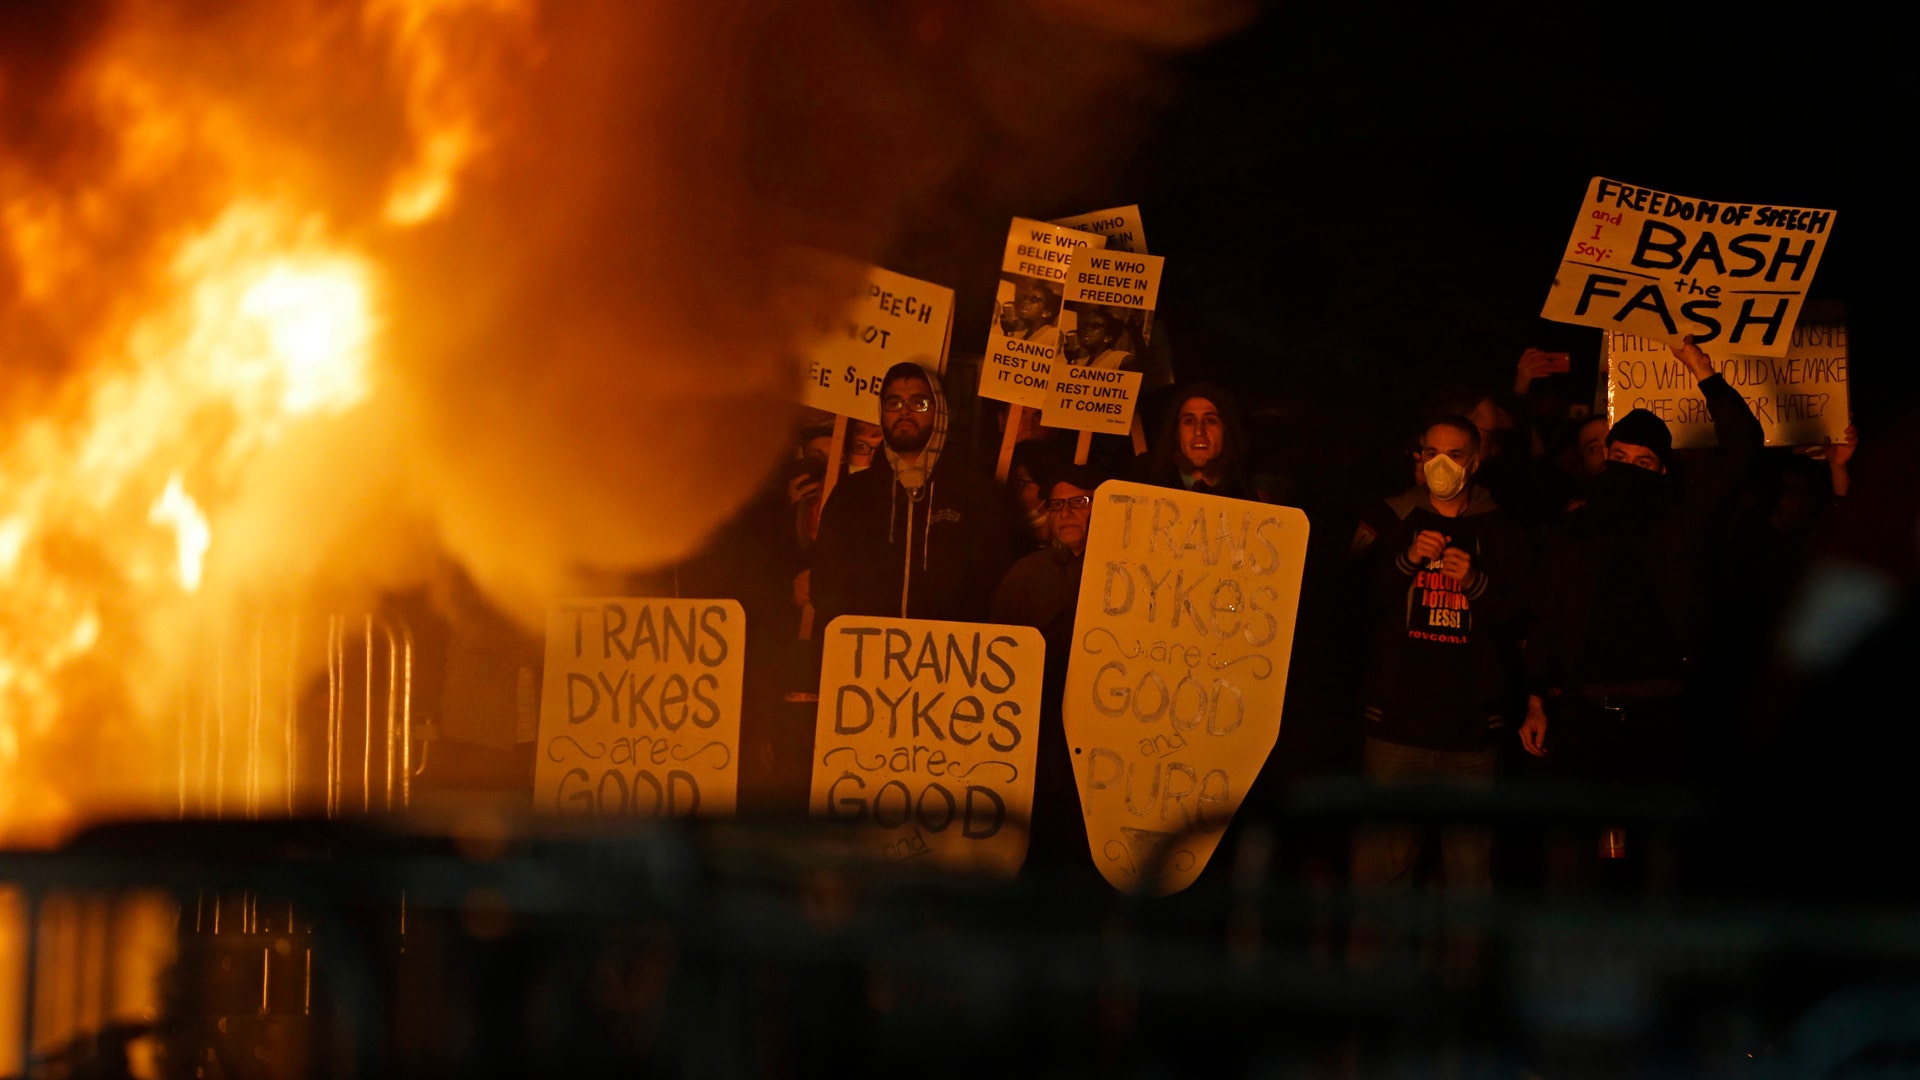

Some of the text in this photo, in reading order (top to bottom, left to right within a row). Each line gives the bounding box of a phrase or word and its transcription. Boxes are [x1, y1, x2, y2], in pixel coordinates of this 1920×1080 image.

[1591, 209, 1622, 226] and
[1596, 180, 1830, 234] FREEDOM OF SPEECH
[1092, 217, 1124, 231] WHO
[1591, 224, 1604, 240] I
[1031, 230, 1053, 244] WE
[1017, 245, 1072, 265] BELIEVE
[1631, 219, 1816, 281] BASH
[1090, 257, 1145, 274] WE WHO
[1078, 272, 1148, 290] BELIEVE IN
[1674, 278, 1722, 299] the
[1080, 289, 1144, 306] FREEDOM
[1574, 274, 1789, 346] FASH
[993, 353, 1028, 369] REST
[1006, 340, 1054, 359] CANNO
[998, 370, 1011, 382] IT
[1069, 368, 1124, 384] CANNOT
[1617, 360, 1647, 390] SO
[1770, 359, 1801, 387] WE
[1802, 356, 1847, 384] MAKE
[1056, 382, 1129, 401] REST UNTIL
[1060, 398, 1122, 415] IT COMES
[1776, 392, 1830, 423] HATE?
[1108, 494, 1282, 576] TRANS
[1429, 609, 1461, 629] LESS!
[561, 604, 729, 668] TRANS
[840, 627, 1020, 695] TRANS
[1150, 641, 1201, 668] are
[1092, 660, 1245, 737] GOOD
[610, 735, 670, 766] are
[1138, 733, 1189, 758] and
[888, 743, 948, 778] are
[556, 767, 701, 819] GOOD
[827, 771, 1007, 840] GOOD
[881, 827, 931, 860] and
